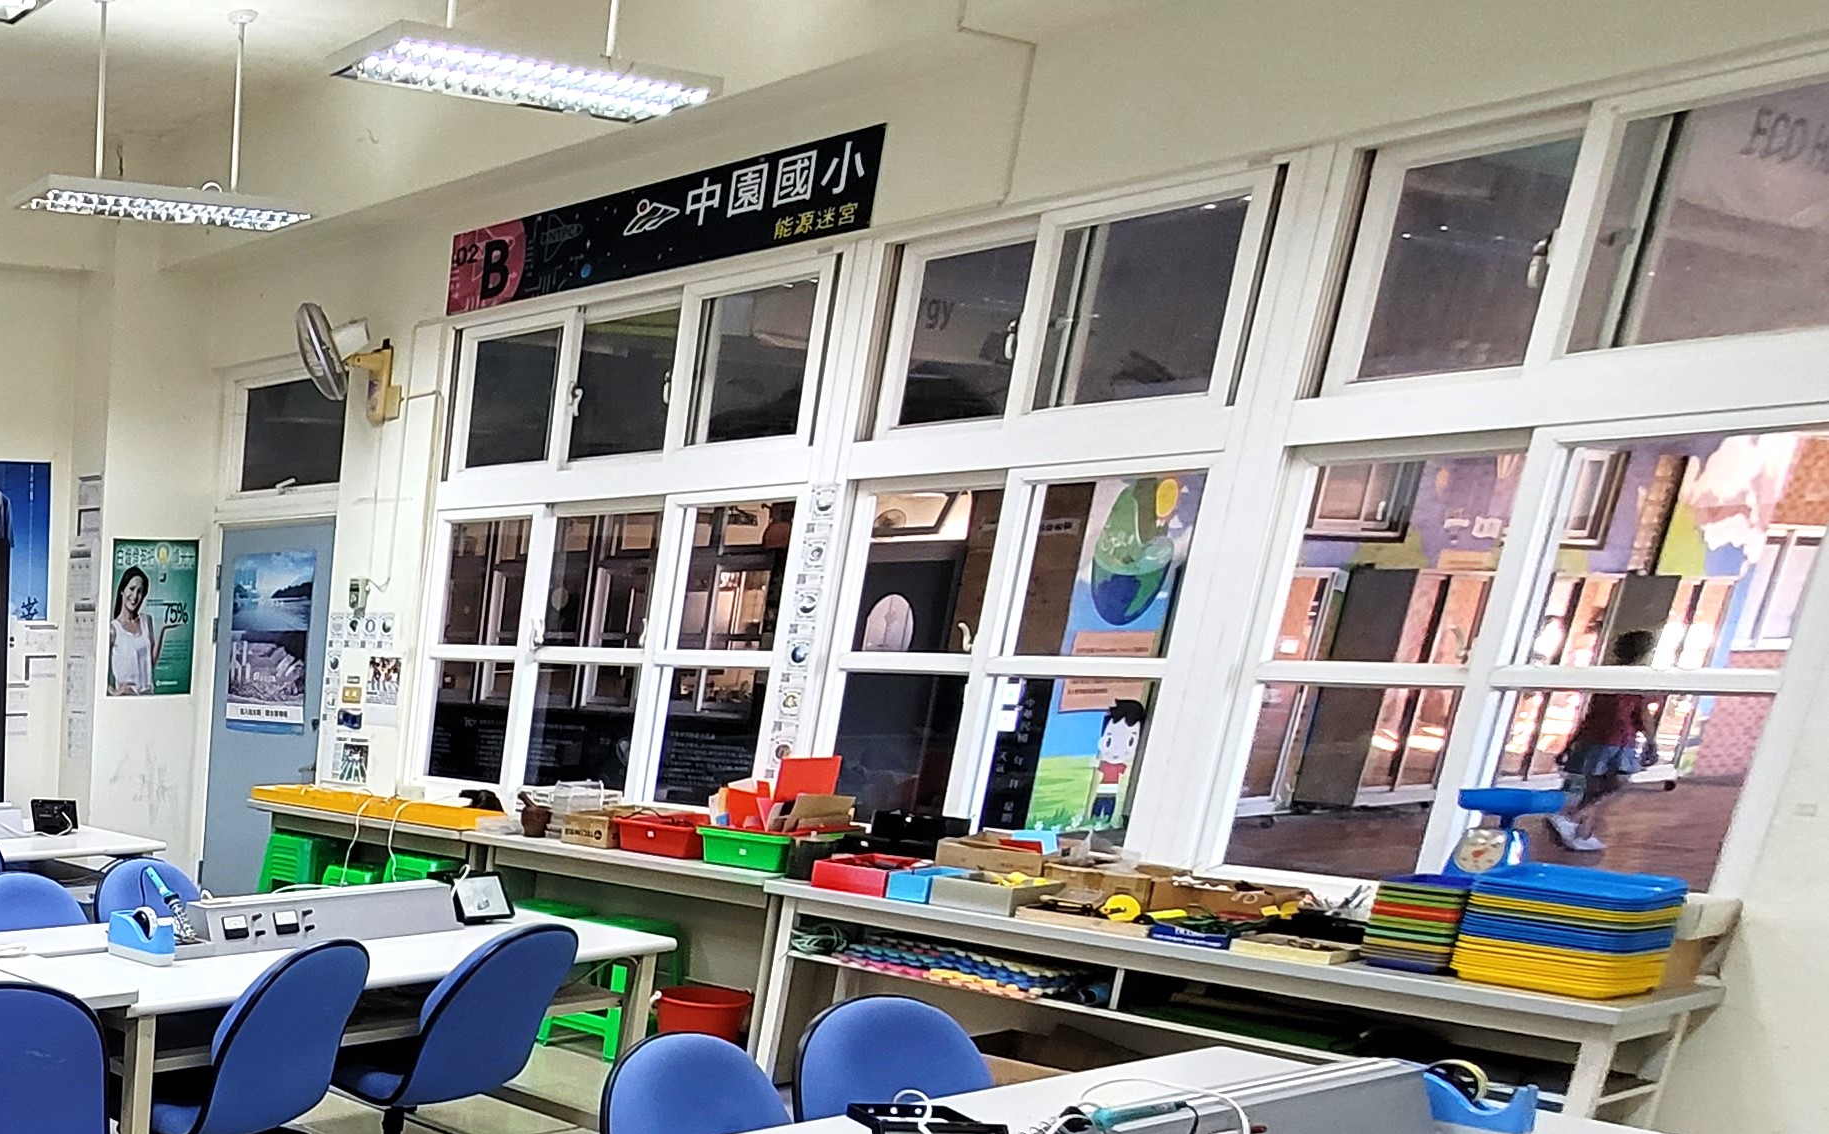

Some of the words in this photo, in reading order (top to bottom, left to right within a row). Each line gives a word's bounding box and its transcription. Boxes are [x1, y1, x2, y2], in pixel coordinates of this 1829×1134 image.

[685, 141, 866, 226] 中園國小
[773, 202, 859, 240] 能源迷宮
[479, 239, 510, 301] B
[920, 296, 956, 332] gy
[162, 602, 189, 625] 75%
